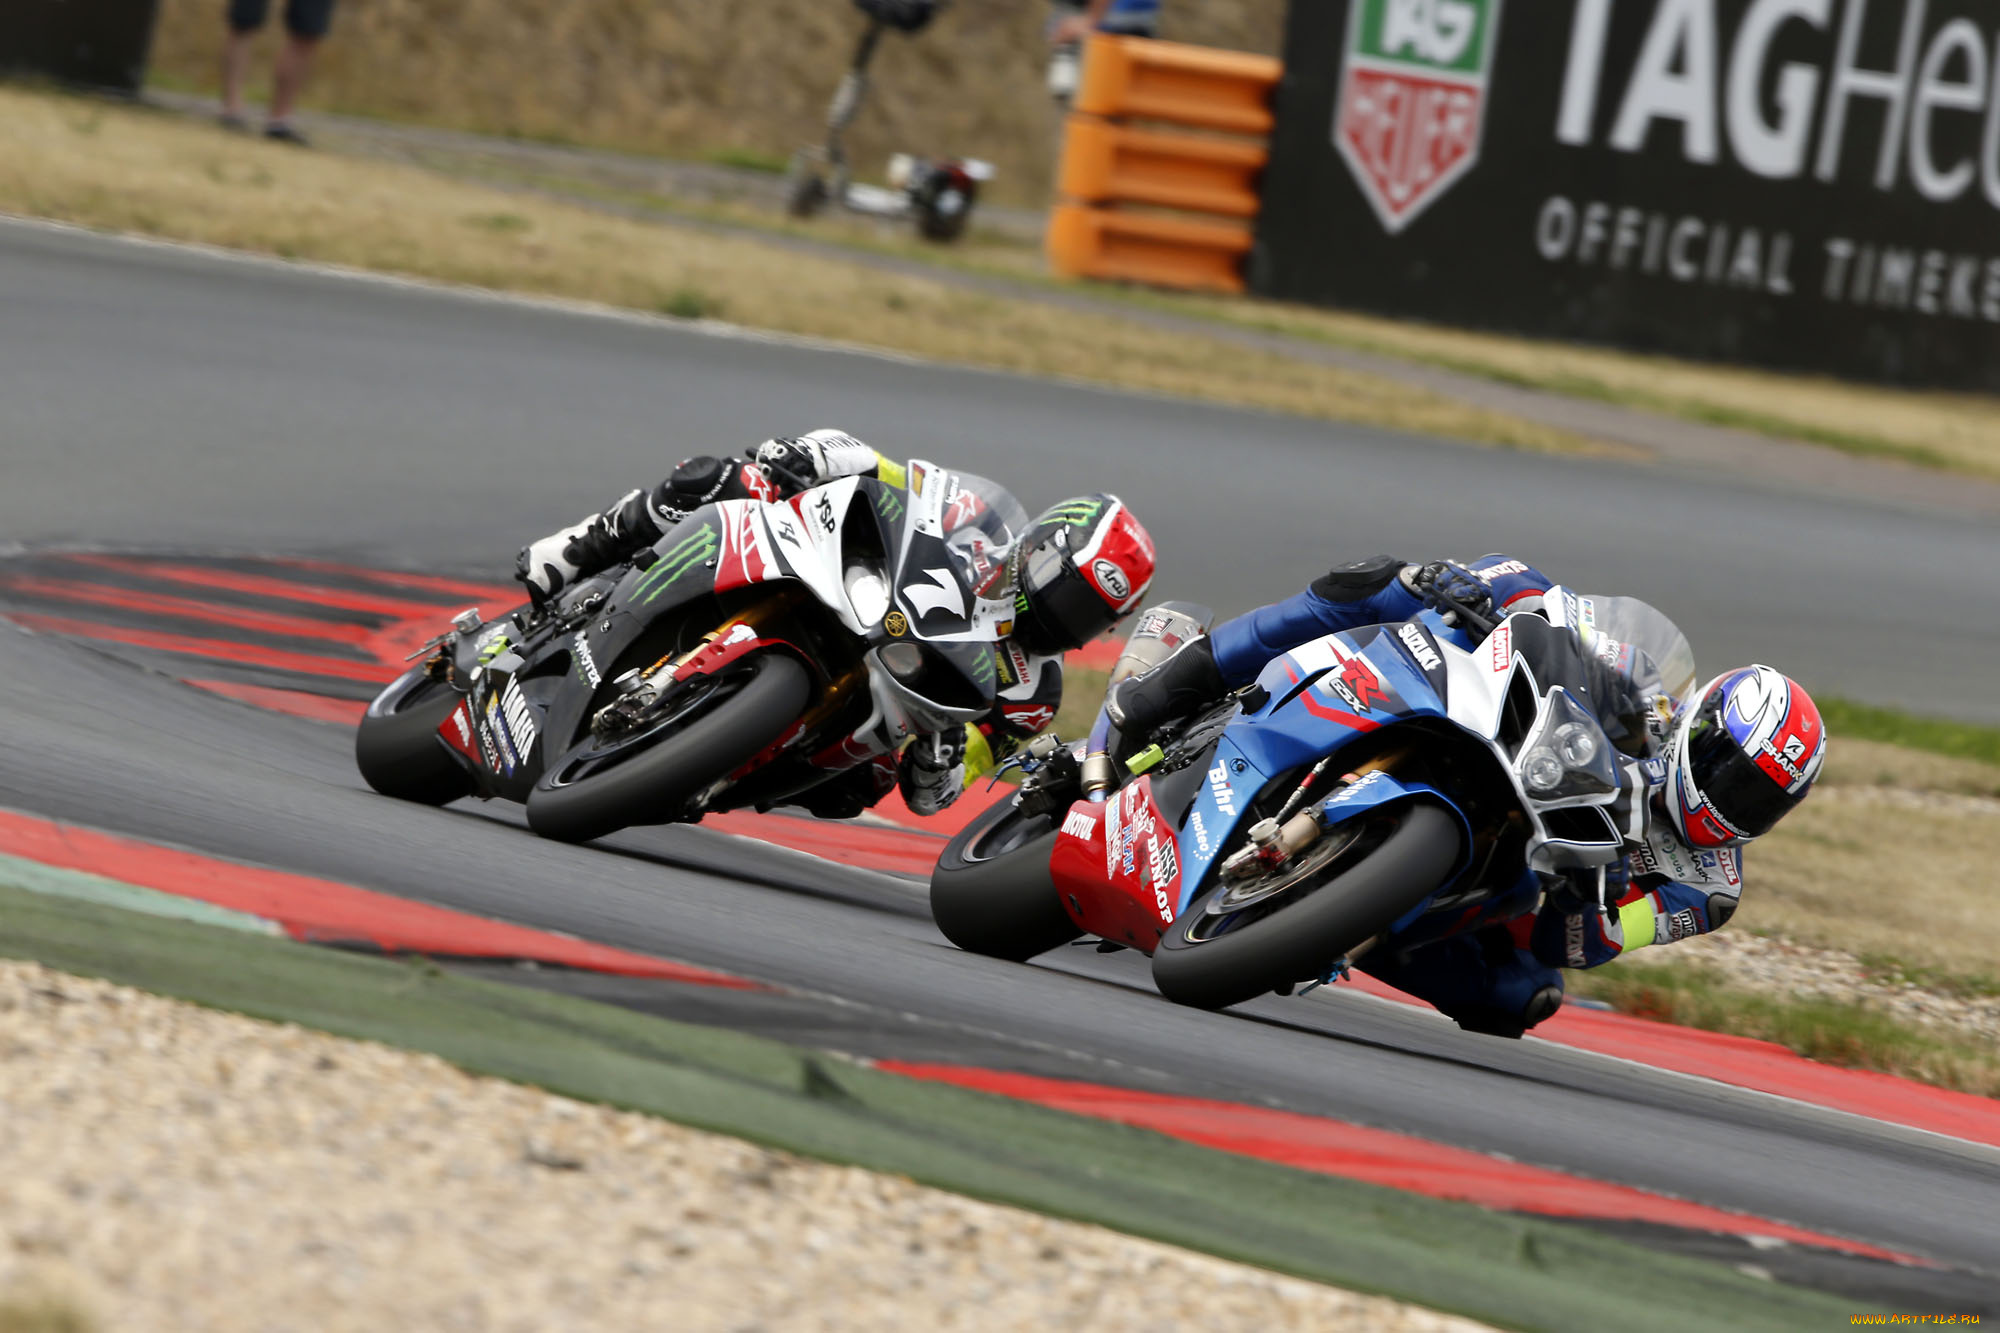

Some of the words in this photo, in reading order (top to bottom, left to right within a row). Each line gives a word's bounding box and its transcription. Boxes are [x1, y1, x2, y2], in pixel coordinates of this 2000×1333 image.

[1536, 196, 1795, 295] OFFICIAL
[814, 491, 836, 534] YSP
[1097, 562, 1127, 595] Arai
[1398, 623, 1442, 672] SUZUKI
[1493, 628, 1509, 672] MOTUL
[1328, 677, 1371, 714] GSX
[501, 672, 536, 766] YAMAHA
[1760, 738, 1805, 782] SHARK
[1208, 759, 1237, 817] Bihr
[1060, 810, 1097, 841] MOTUL
[1191, 811, 1210, 852] moteo
[1147, 833, 1174, 924] DUNLOP
[1688, 849, 1713, 883] HARK
[1717, 848, 1740, 886] OTUL
